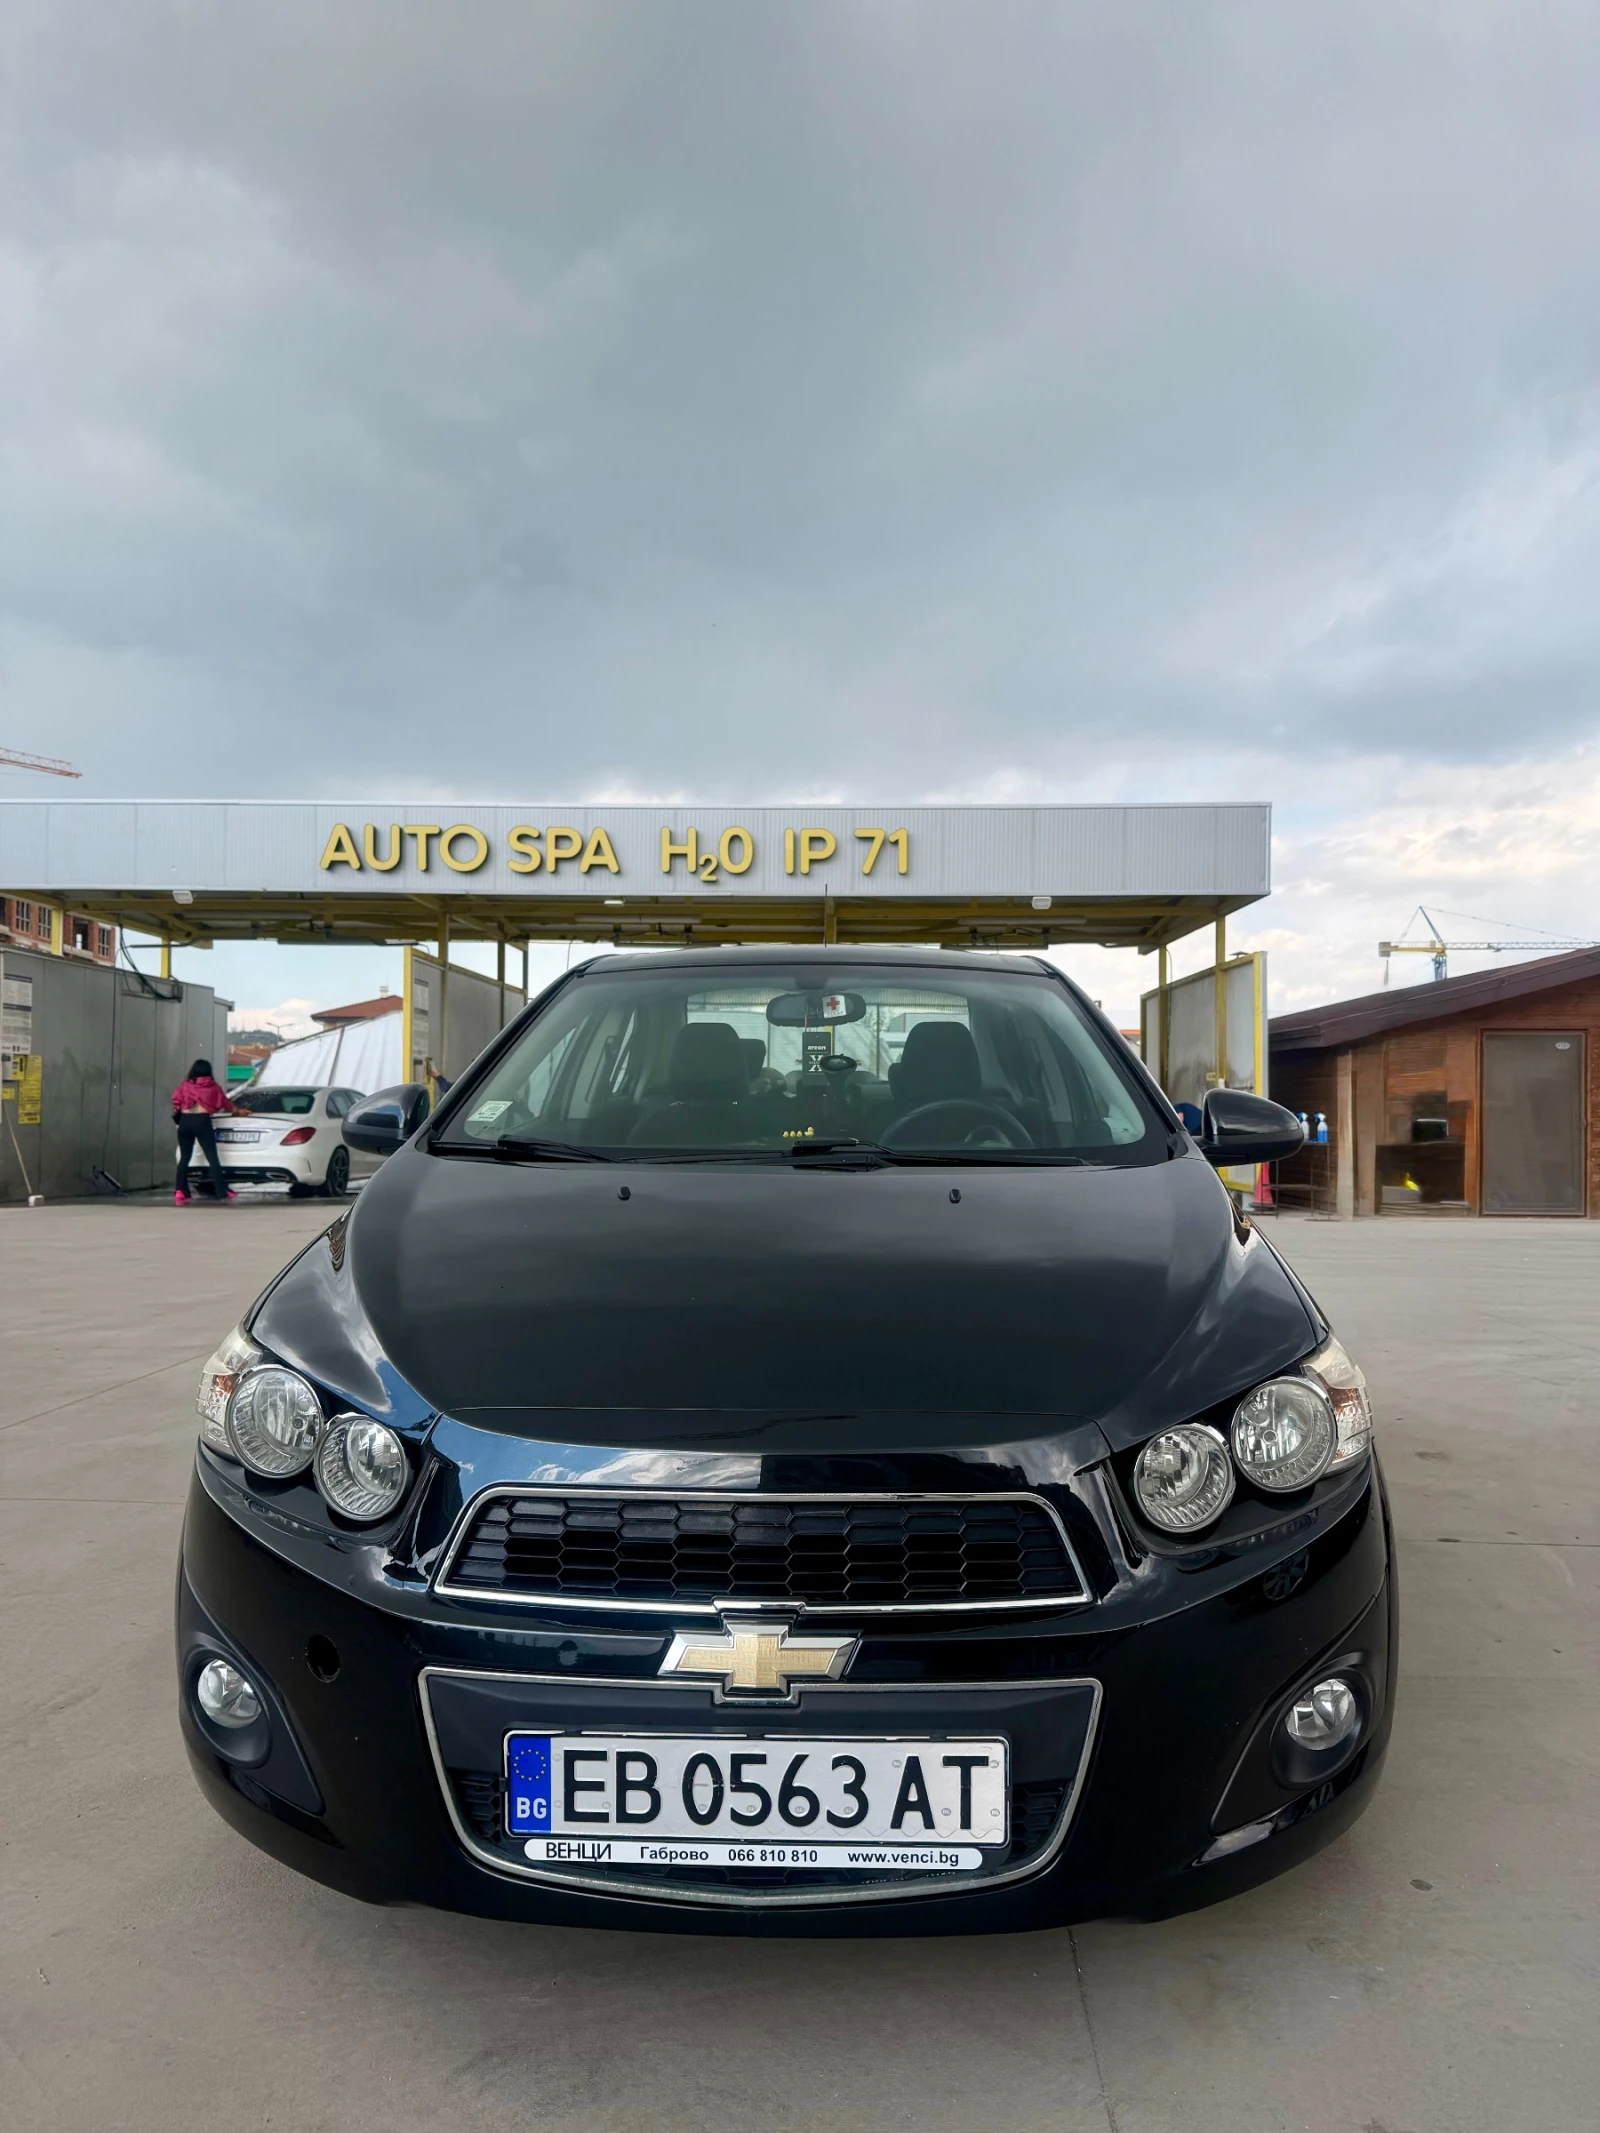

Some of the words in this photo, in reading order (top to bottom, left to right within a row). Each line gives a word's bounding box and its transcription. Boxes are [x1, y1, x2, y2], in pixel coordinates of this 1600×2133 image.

[320, 823, 489, 872] AUTO
[507, 825, 619, 873] SPA
[784, 827, 837, 875] IP
[854, 827, 909, 875] 71
[516, 1797, 547, 1819] BG
[563, 1750, 662, 1824] EB
[682, 1752, 869, 1829] 0563
[890, 1755, 989, 1830] AT
[546, 1842, 612, 1861] ВЕНЦИ
[640, 1846, 709, 1862] Габрово
[728, 1849, 755, 1861] 066
[760, 1849, 786, 1862] 810
[791, 1850, 818, 1863] 810
[848, 1850, 959, 1867] www.venci.bg
